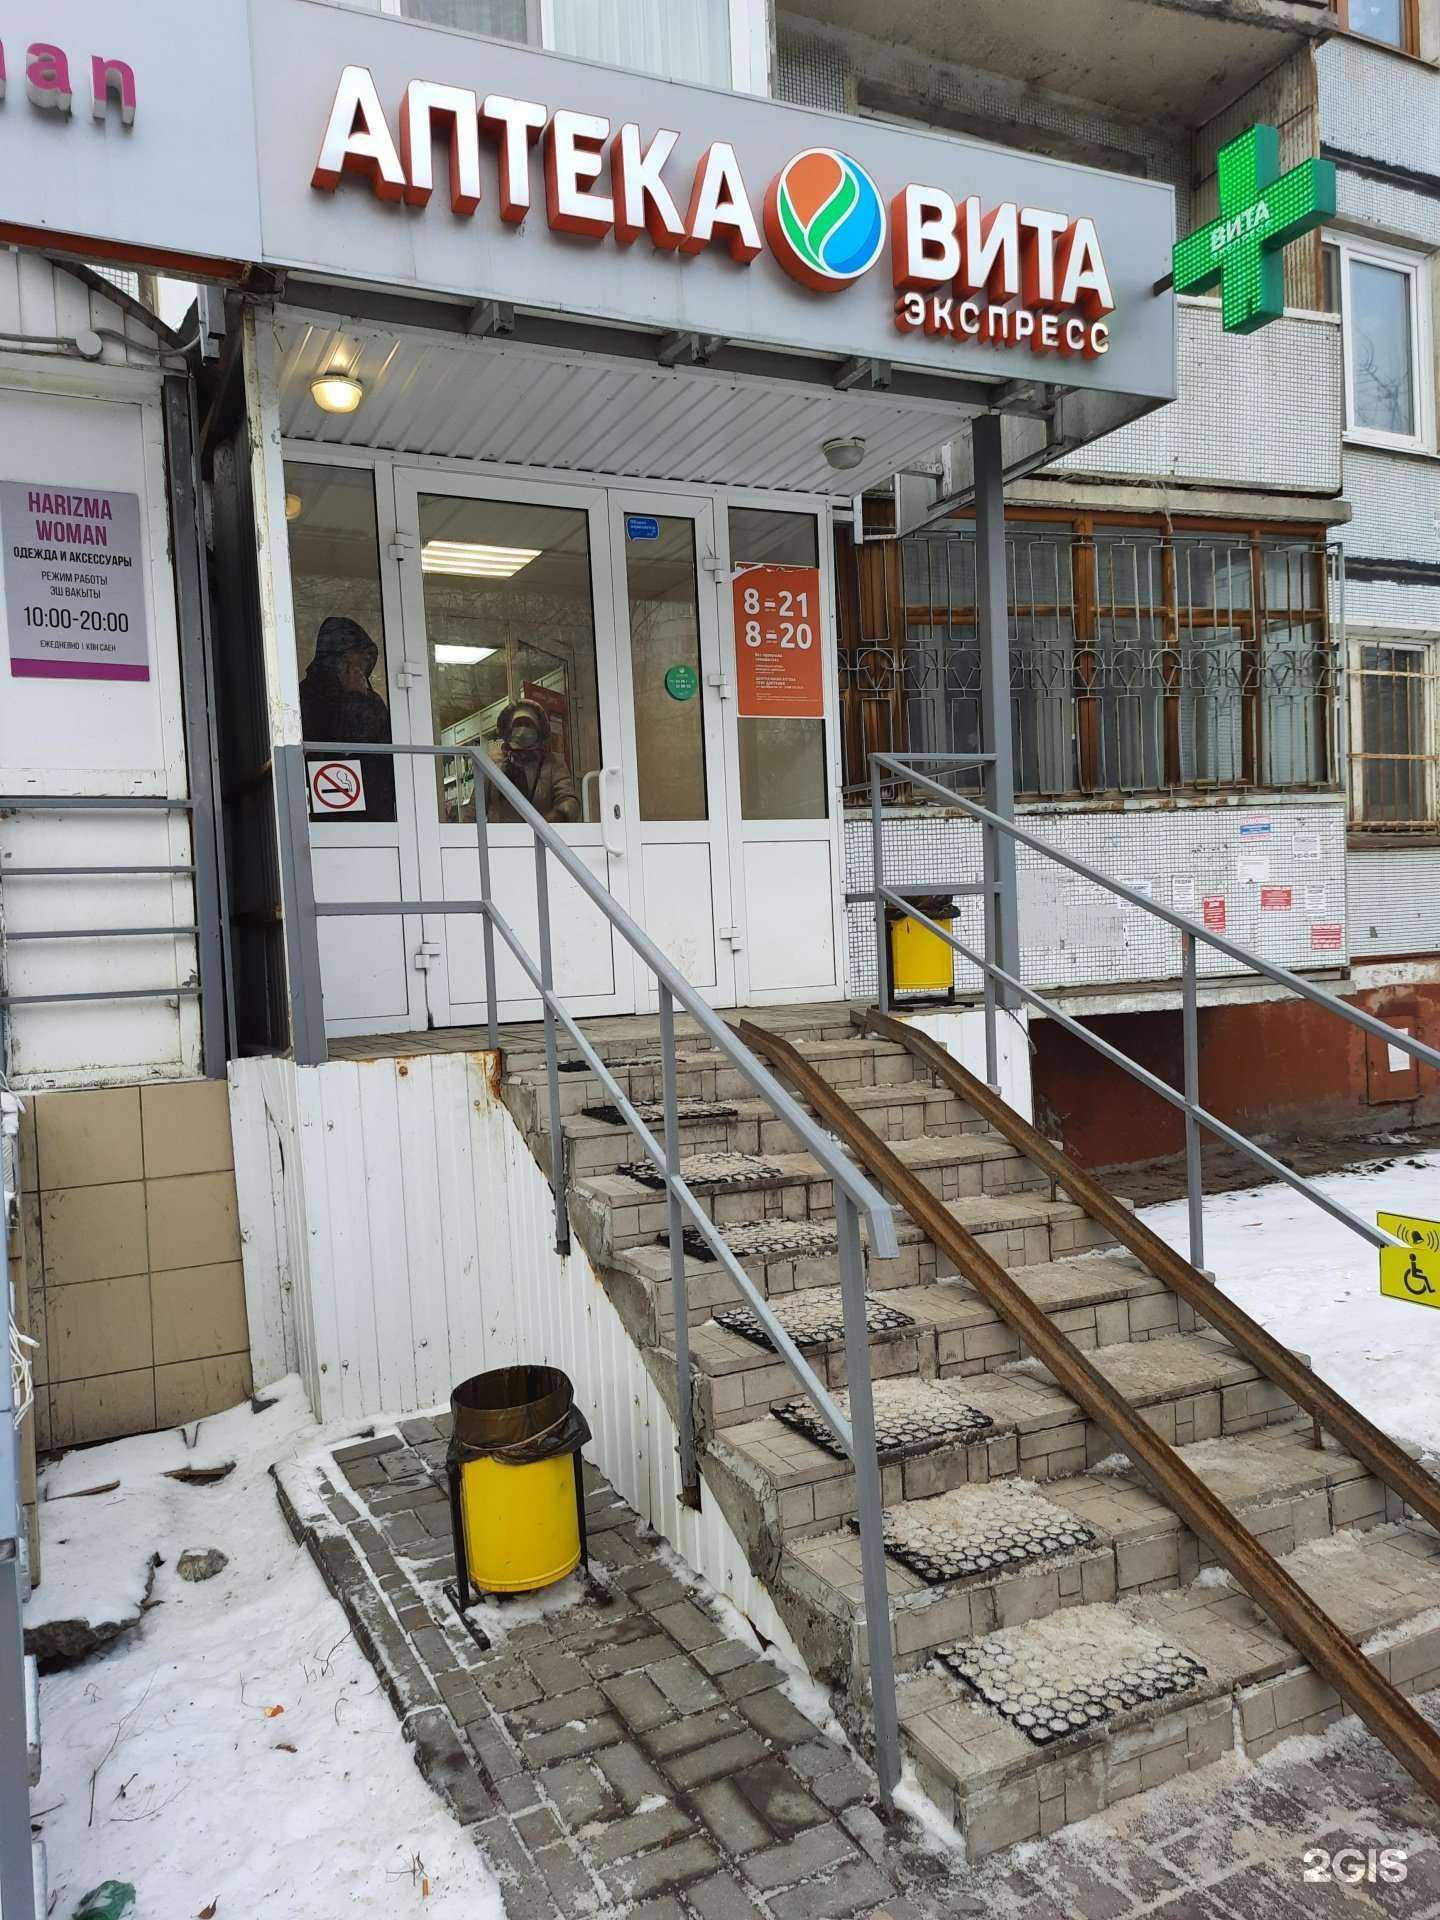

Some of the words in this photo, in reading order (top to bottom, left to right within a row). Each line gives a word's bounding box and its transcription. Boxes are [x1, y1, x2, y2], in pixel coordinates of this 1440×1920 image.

[0, 42, 136, 108] an
[313, 65, 763, 252] АПТЕКА
[900, 183, 1115, 312] ВИТА
[1210, 199, 1271, 252] ВИТА
[902, 291, 1109, 354] ЭКСПРЕСС
[28, 491, 113, 521] HARIZMA
[36, 519, 108, 547] WOMAN
[13, 546, 58, 562] ОДЕЖДА
[60, 550, 67, 562] И
[69, 551, 132, 567] АКСЕССУАРЫ
[41, 570, 73, 583] РЕЖИМ
[74, 573, 108, 586] РАБОТЫ
[65, 587, 101, 600] ВАКЫТЫ
[24, 605, 129, 633] 10:00-20:00
